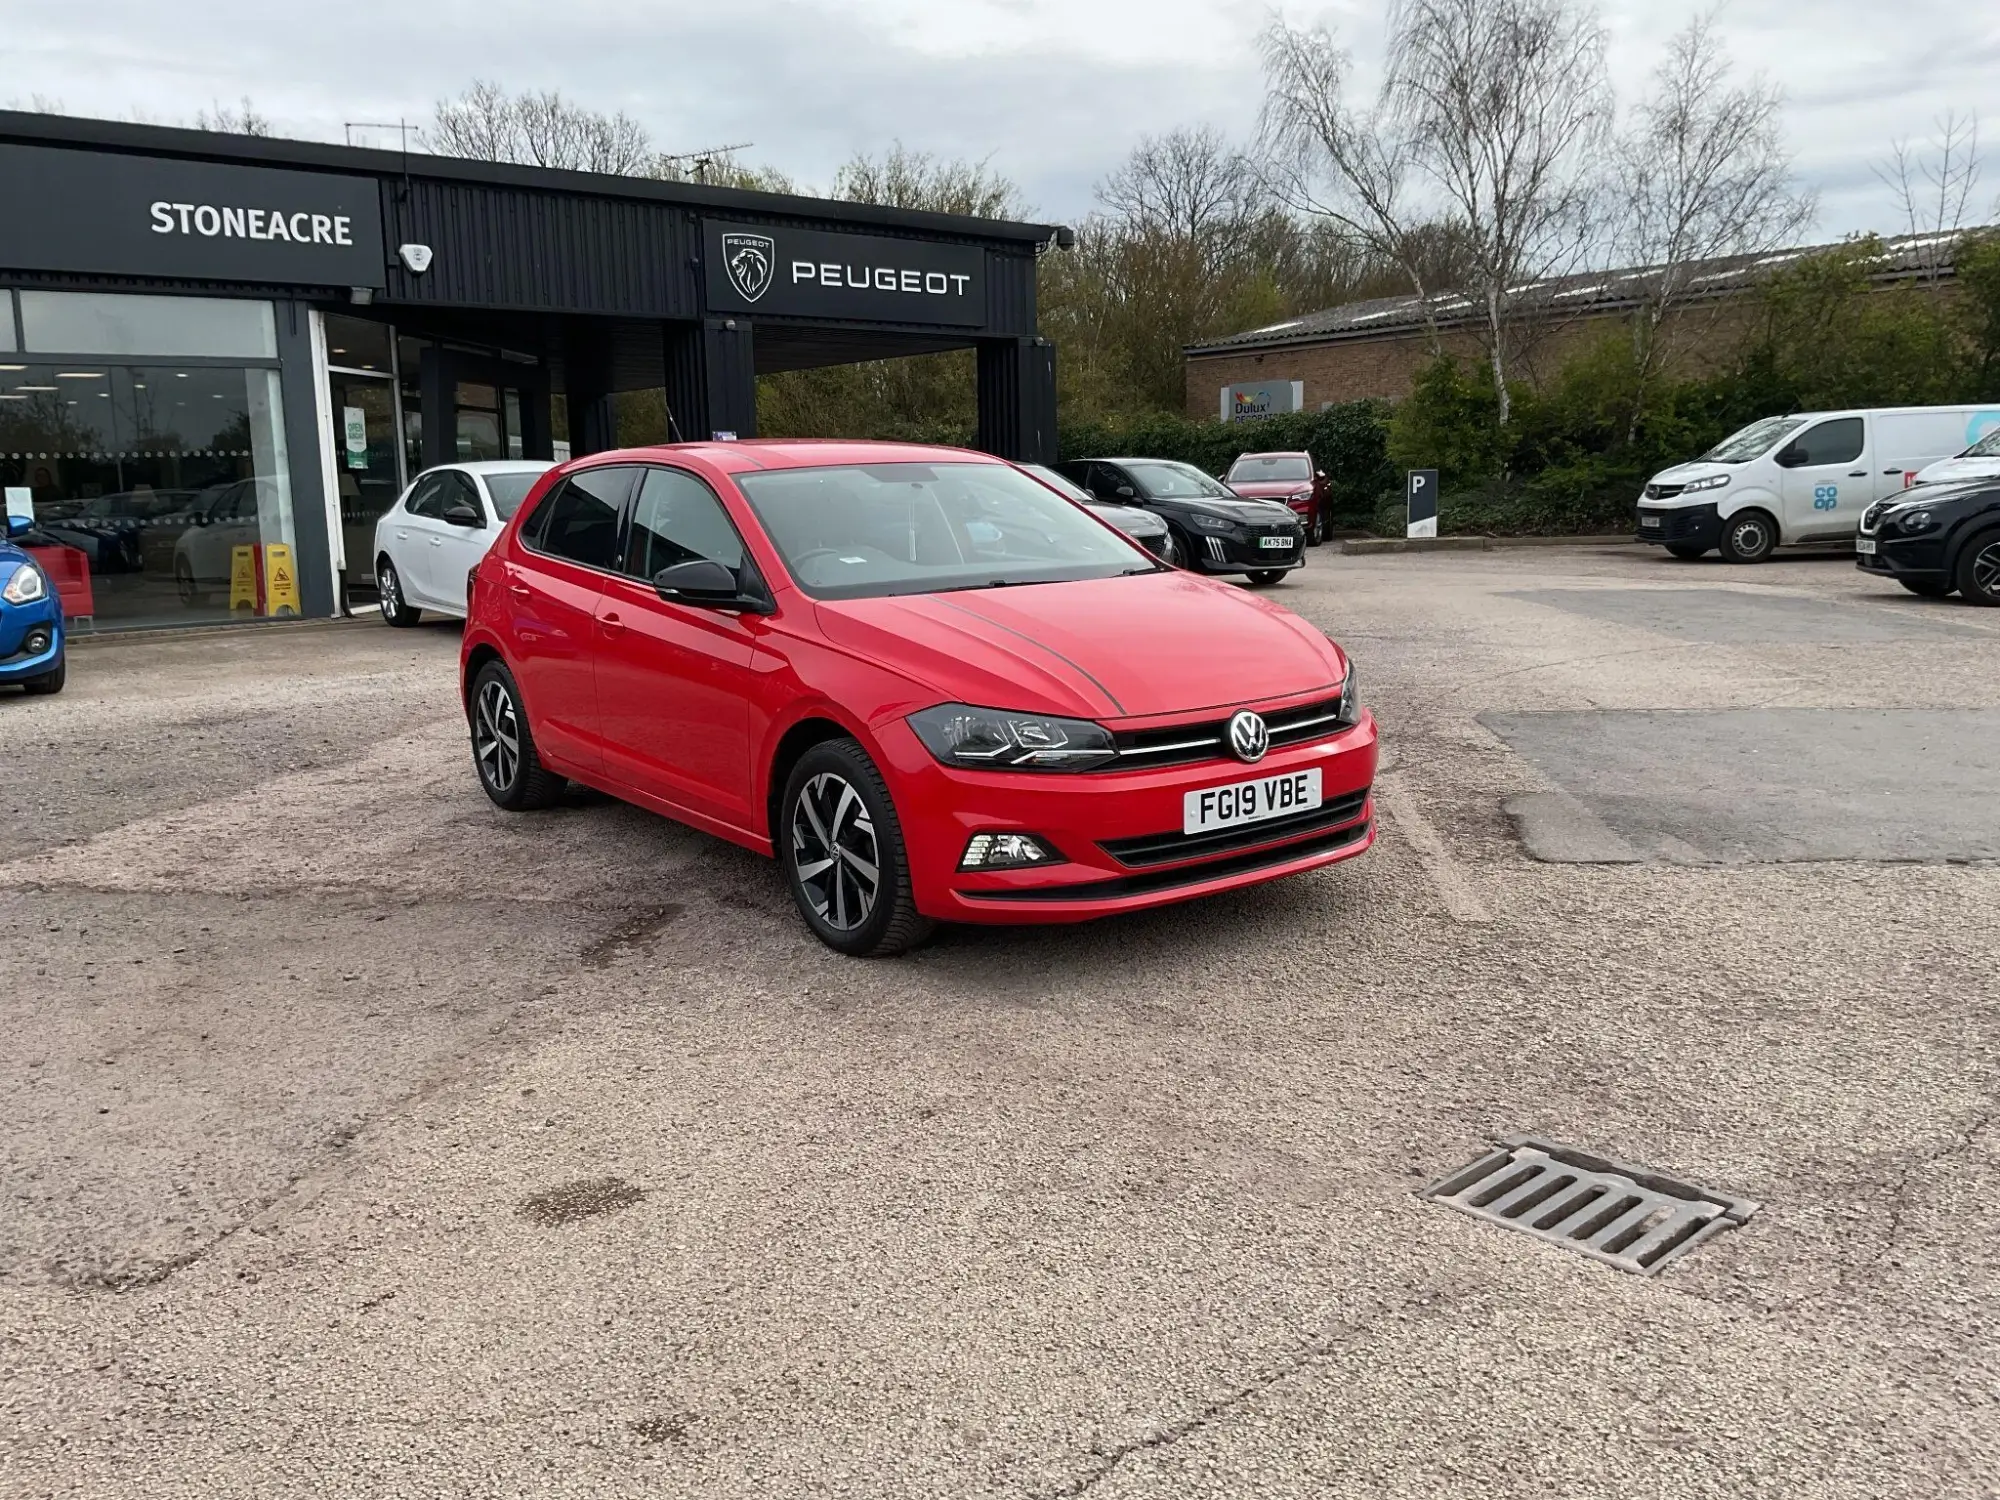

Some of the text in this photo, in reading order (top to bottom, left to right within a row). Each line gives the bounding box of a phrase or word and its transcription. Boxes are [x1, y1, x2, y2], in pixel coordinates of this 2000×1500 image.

[150, 201, 353, 246] STONEACRE
[727, 238, 770, 248] PEUGEOT
[792, 261, 970, 296] PEUGEOT
[1235, 402, 1267, 414] Dulux
[1412, 475, 1426, 494] P
[1200, 774, 1308, 824] FG19 VBE
